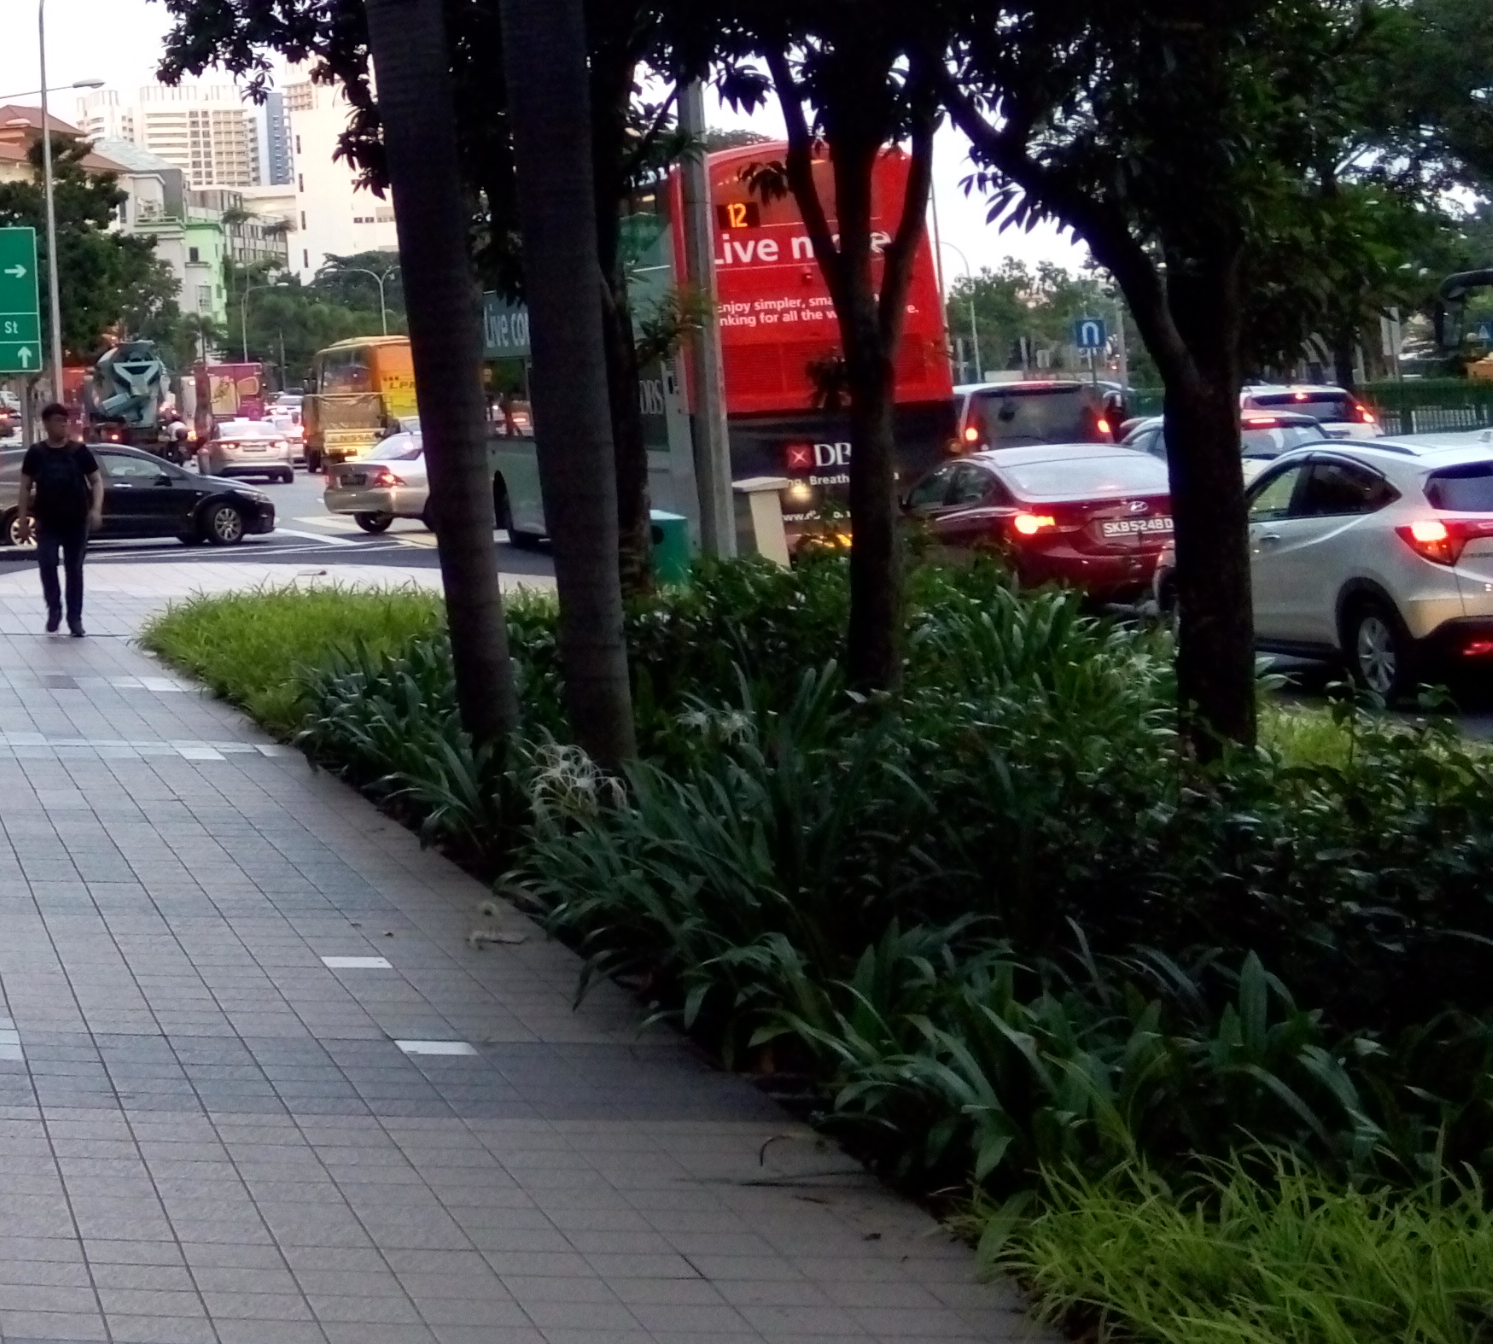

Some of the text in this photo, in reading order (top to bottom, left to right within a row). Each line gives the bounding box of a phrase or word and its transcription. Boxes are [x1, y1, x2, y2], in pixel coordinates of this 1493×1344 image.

[727, 203, 748, 228] 12
[754, 296, 806, 313] simpler,
[719, 313, 756, 327] nking
[759, 312, 778, 324] for
[782, 309, 798, 322] all
[801, 309, 819, 321] the
[4, 321, 18, 334] St
[813, 442, 852, 467] DB
[809, 473, 851, 486] Breath
